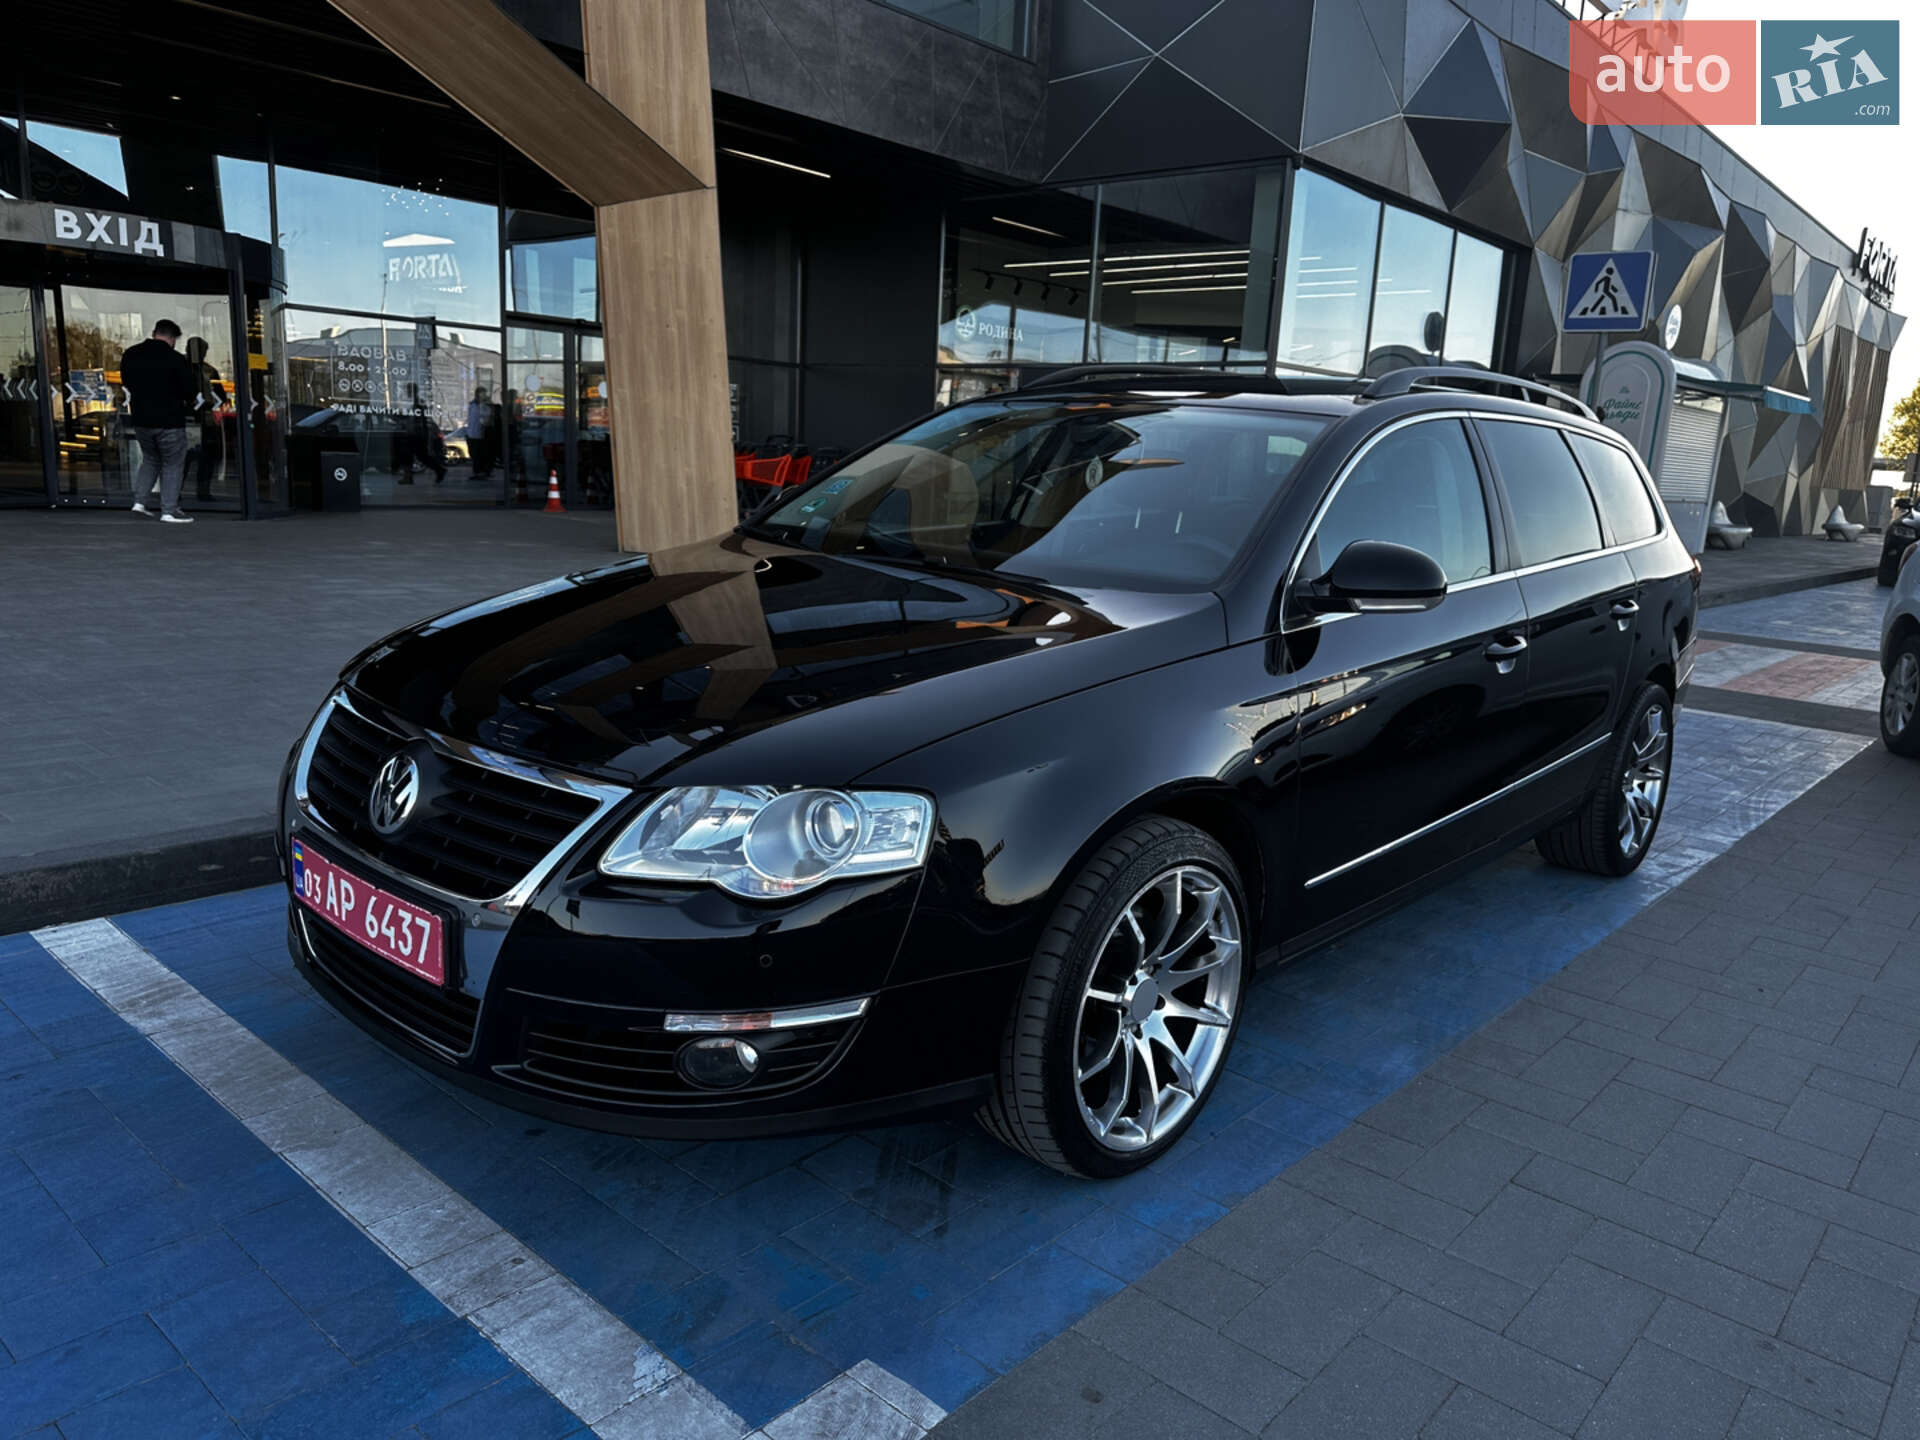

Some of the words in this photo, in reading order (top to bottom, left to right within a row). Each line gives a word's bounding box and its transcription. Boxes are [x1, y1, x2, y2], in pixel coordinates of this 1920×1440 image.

[54, 208, 165, 257] ВХІД
[304, 868, 322, 904] 03
[326, 871, 355, 922] AP
[365, 895, 431, 964] 6437
